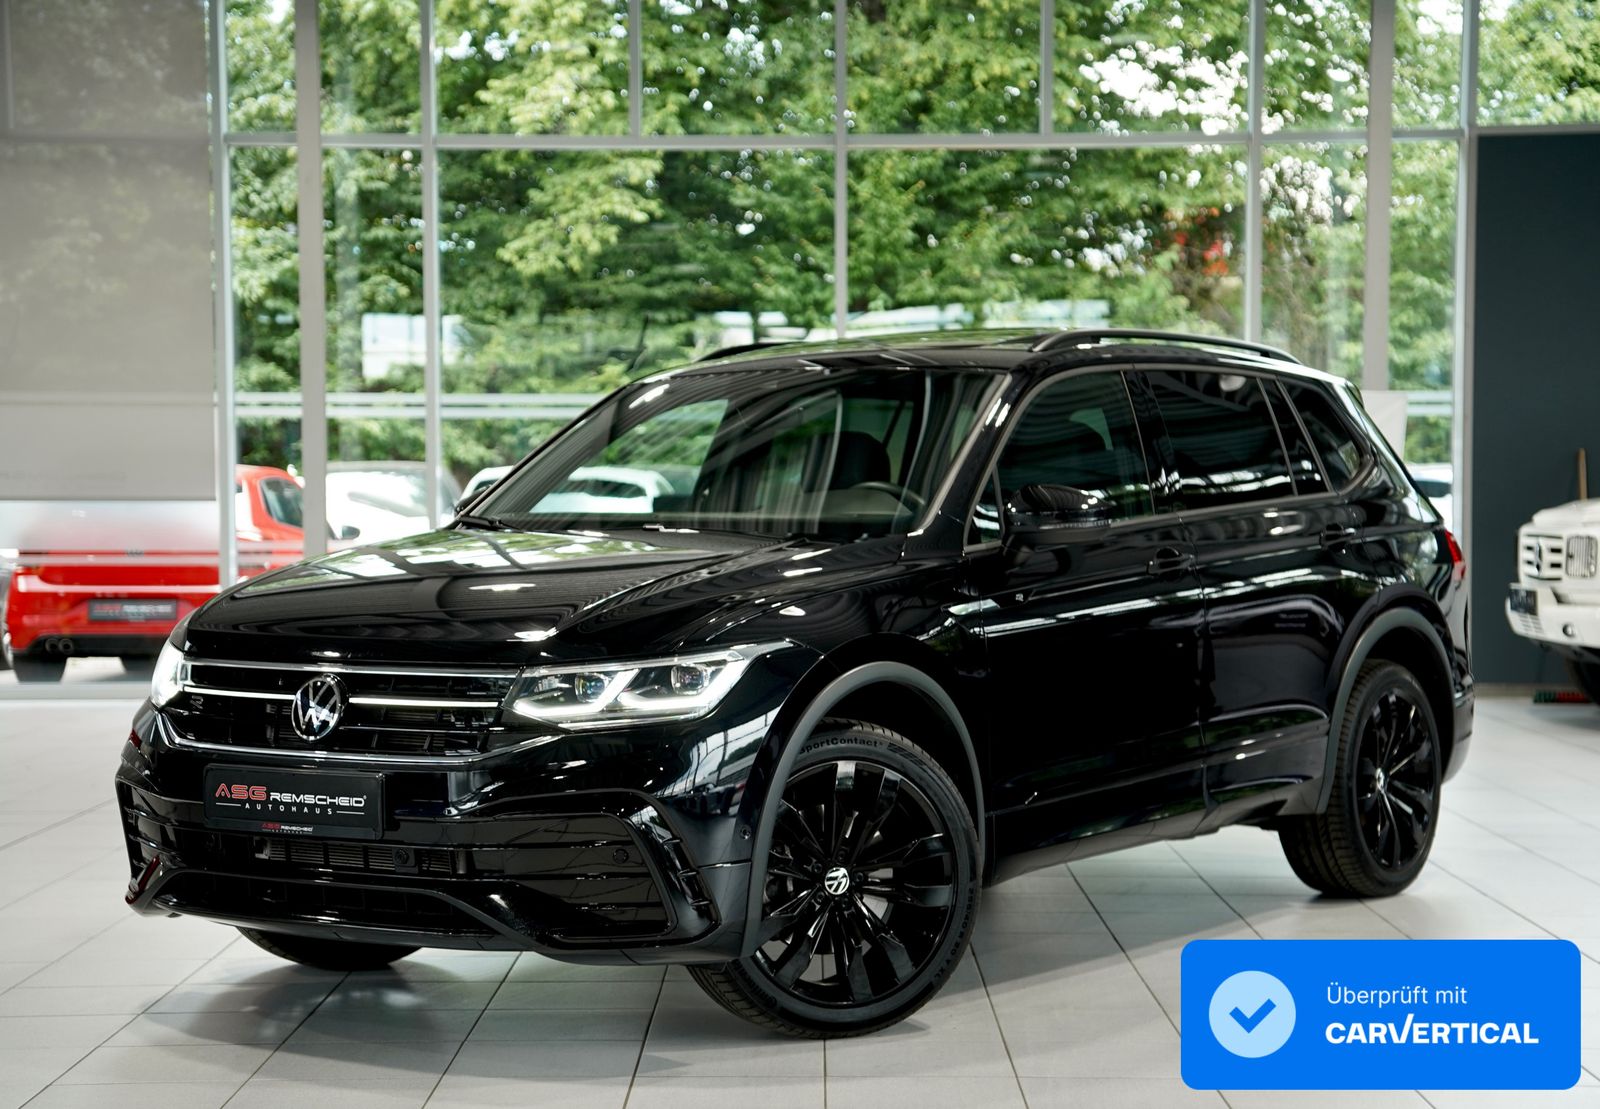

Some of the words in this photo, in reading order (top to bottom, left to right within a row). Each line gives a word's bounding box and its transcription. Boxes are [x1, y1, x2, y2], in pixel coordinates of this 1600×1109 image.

[215, 783, 267, 801] ASG
[270, 792, 365, 807] REMSCHEID
[245, 804, 333, 815] AUTOHAUS
